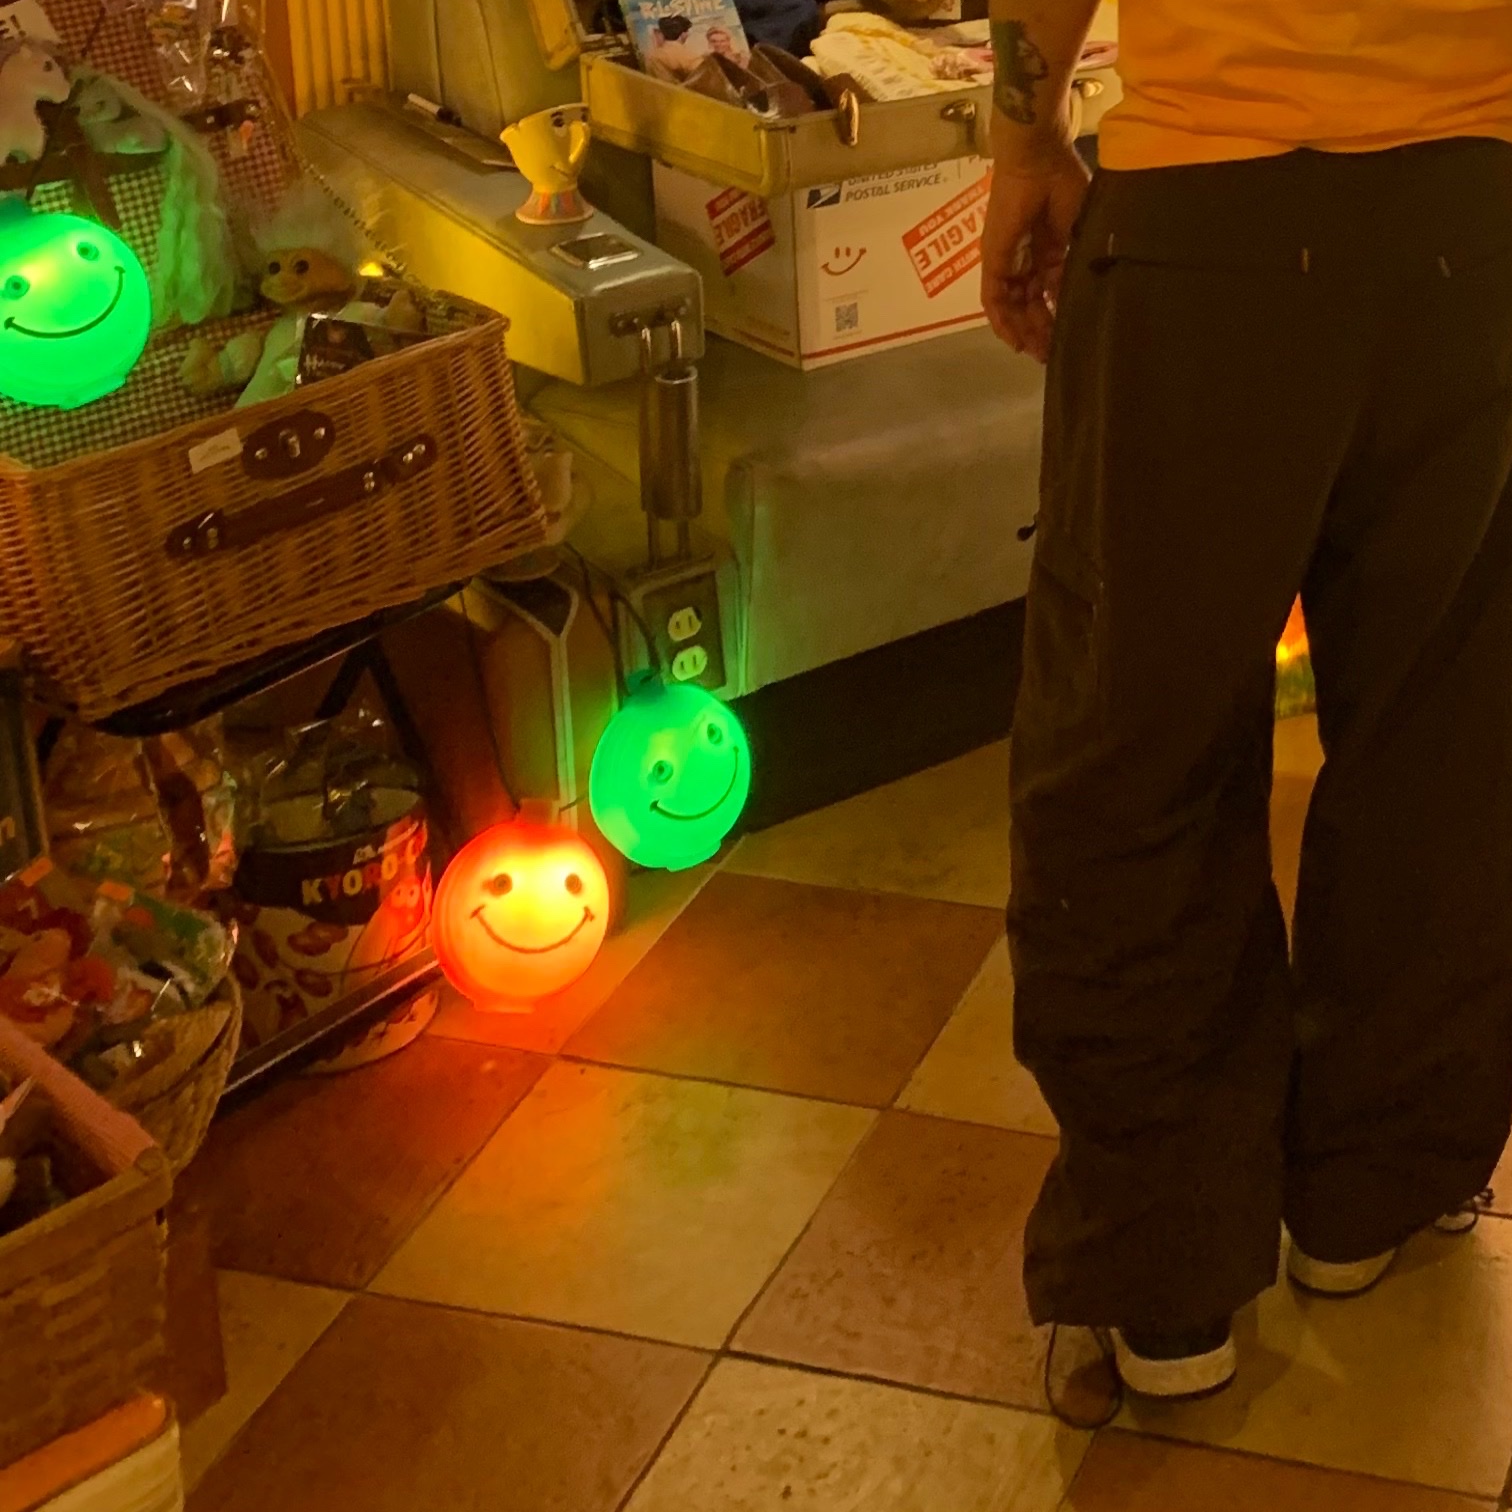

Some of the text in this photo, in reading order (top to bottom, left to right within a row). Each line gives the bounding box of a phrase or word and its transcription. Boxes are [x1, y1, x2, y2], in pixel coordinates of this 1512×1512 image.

[844, 173, 942, 203] POSTAL SERVICE
[914, 201, 988, 271] AGILE
[918, 214, 945, 237] YOU
